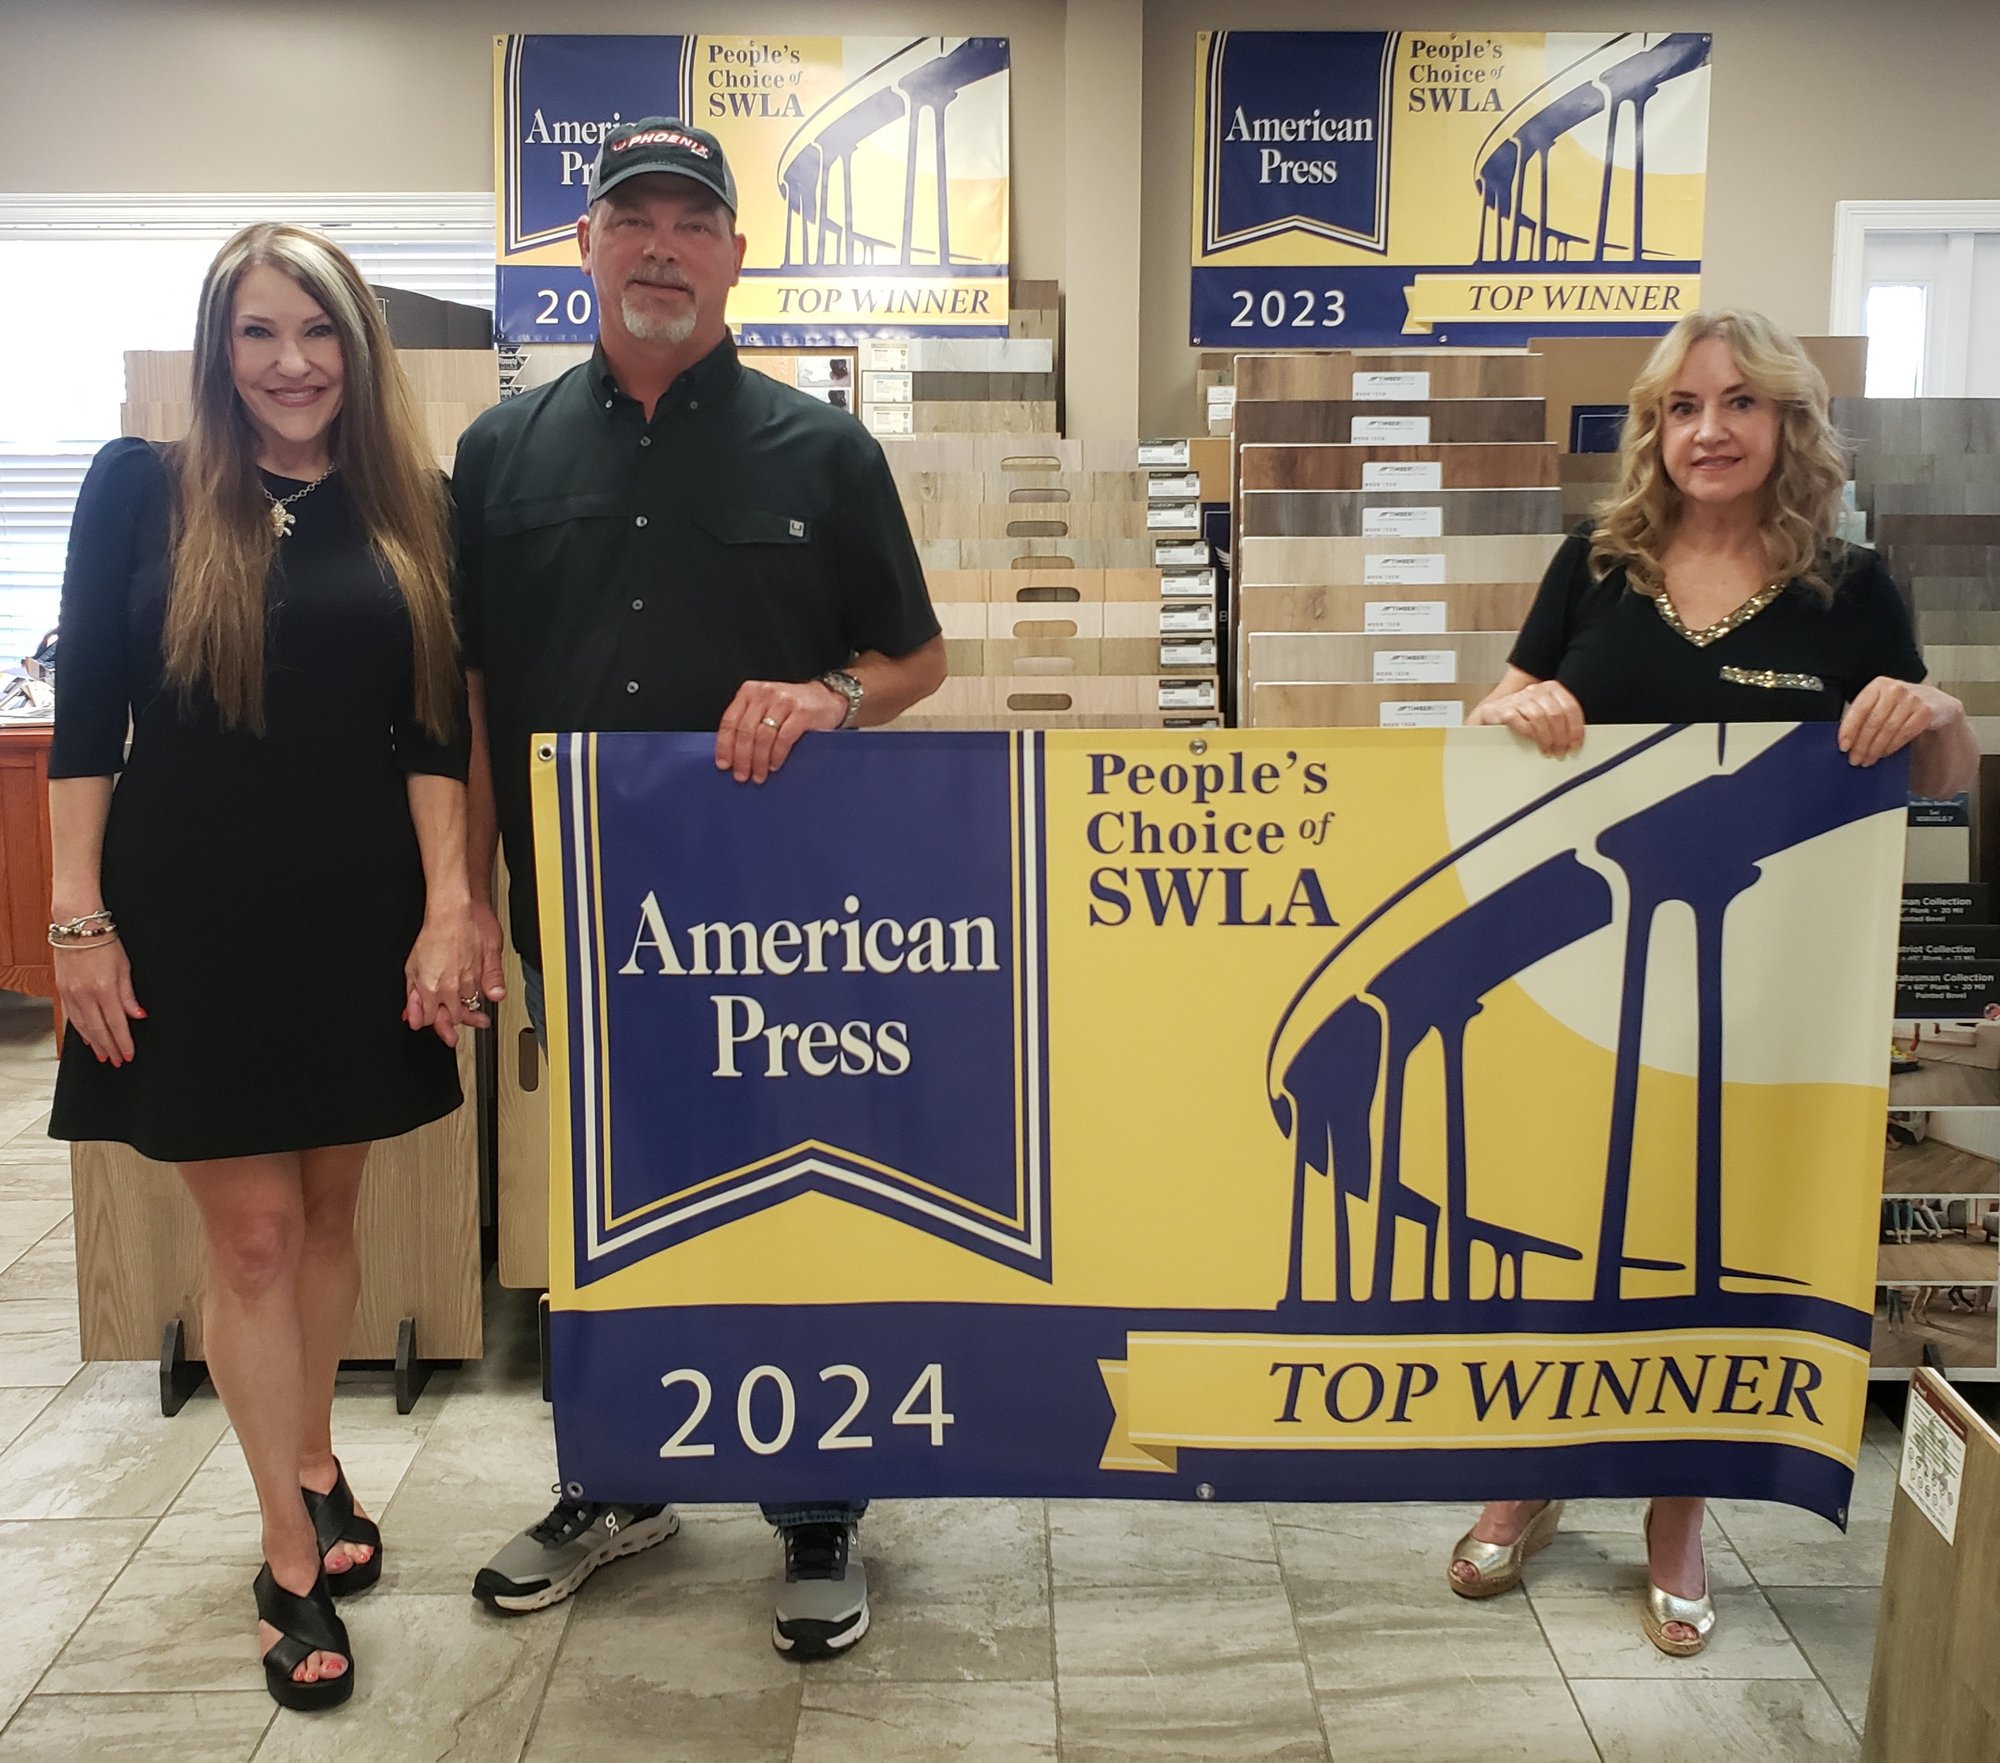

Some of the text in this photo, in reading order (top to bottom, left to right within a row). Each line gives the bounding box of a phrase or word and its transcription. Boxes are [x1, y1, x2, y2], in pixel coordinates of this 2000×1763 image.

[708, 44, 801, 68] People's
[1410, 39, 1503, 61] People's
[708, 69, 803, 89] Choice of
[1409, 64, 1504, 84] Choice of
[708, 92, 805, 118] SWLA
[1408, 87, 1505, 113] SWLA
[1225, 104, 1374, 143] American
[627, 131, 710, 156] PHOENIX
[1258, 148, 1337, 185] Press
[536, 288, 593, 325] 20
[777, 287, 991, 314] TOP WINNER
[1230, 289, 1346, 327] 2023
[1468, 284, 1681, 312] TOP WINNER
[1086, 751, 1328, 804] People's
[1086, 810, 1336, 854] Choice of
[1089, 866, 1340, 927] SWLA
[1922, 897, 1972, 906] Collection
[617, 890, 1001, 976] American
[1925, 945, 1975, 953] Collection
[1943, 973, 1994, 982] Collection
[709, 994, 911, 1077] Press
[1268, 1353, 1824, 1426] TOP WINNER
[659, 1362, 955, 1459] 2024
